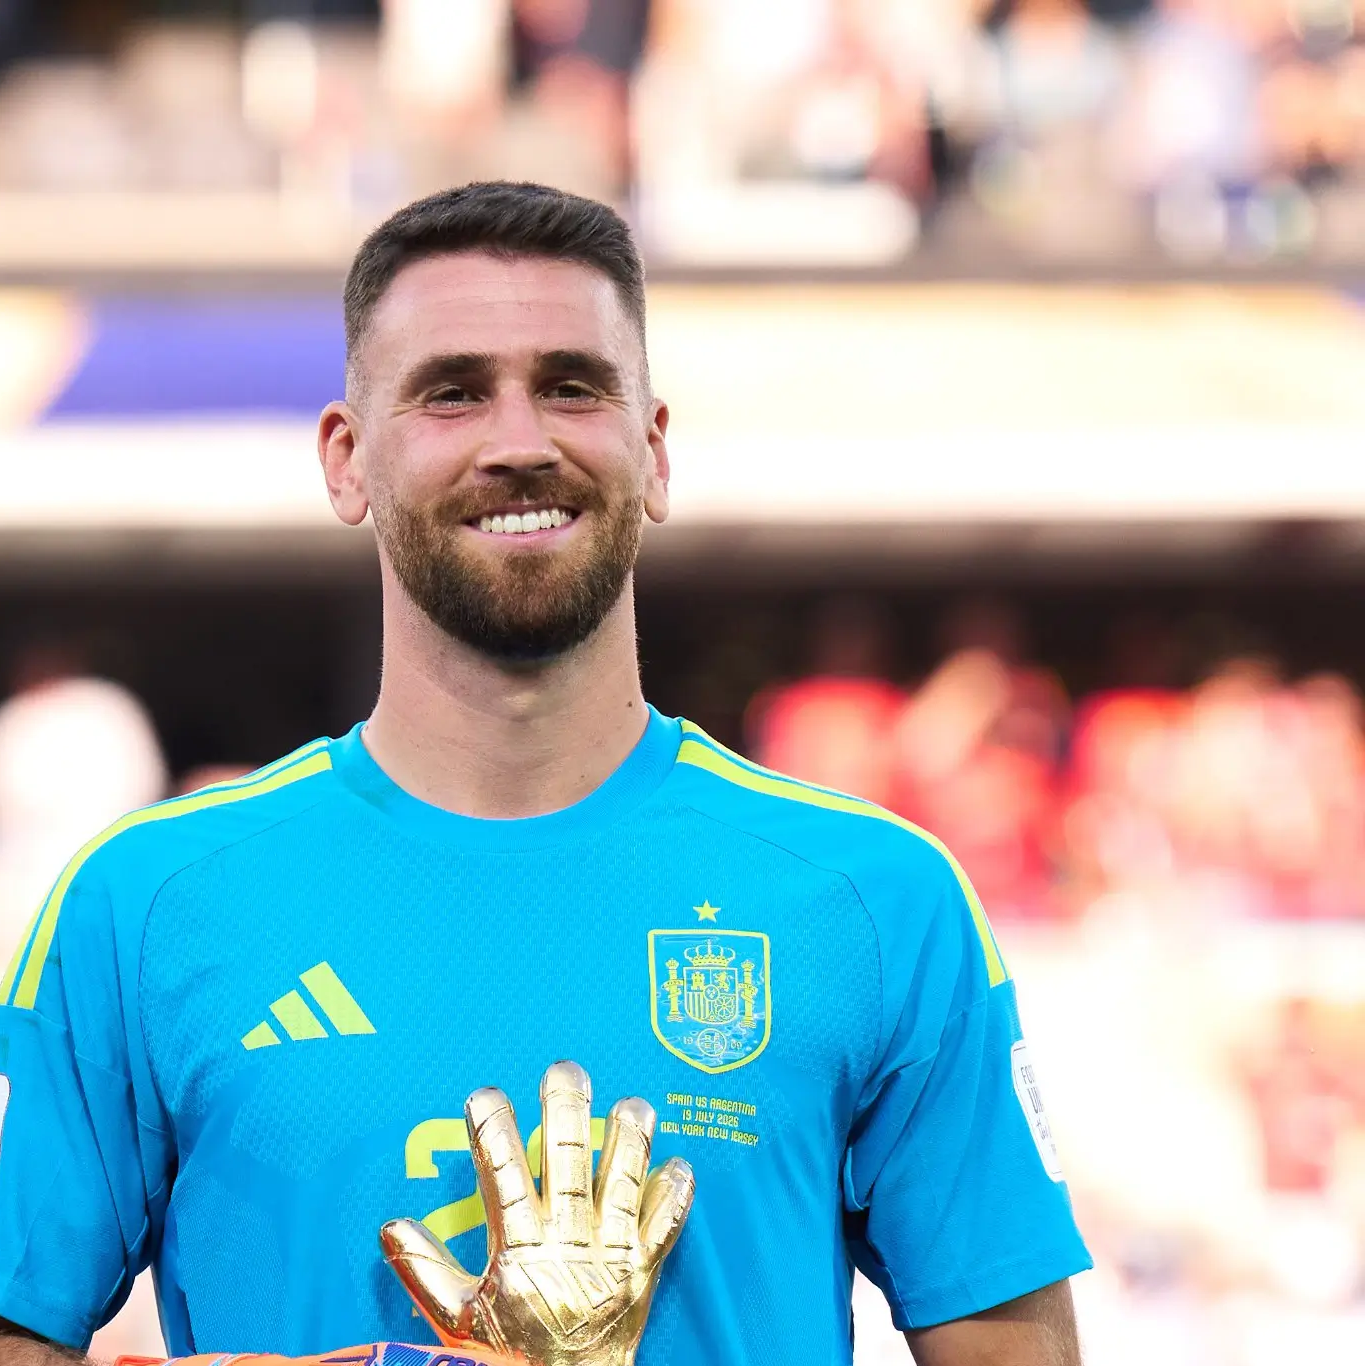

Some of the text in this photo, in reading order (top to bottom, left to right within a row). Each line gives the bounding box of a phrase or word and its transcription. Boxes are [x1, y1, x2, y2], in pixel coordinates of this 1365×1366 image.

[667, 1093, 692, 1106] SPAIN
[710, 1098, 756, 1116] ARGENTINA
[683, 1110, 739, 1127] 19 JULY 2026
[661, 1122, 758, 1147] NEW YORK NEW JERSEY
